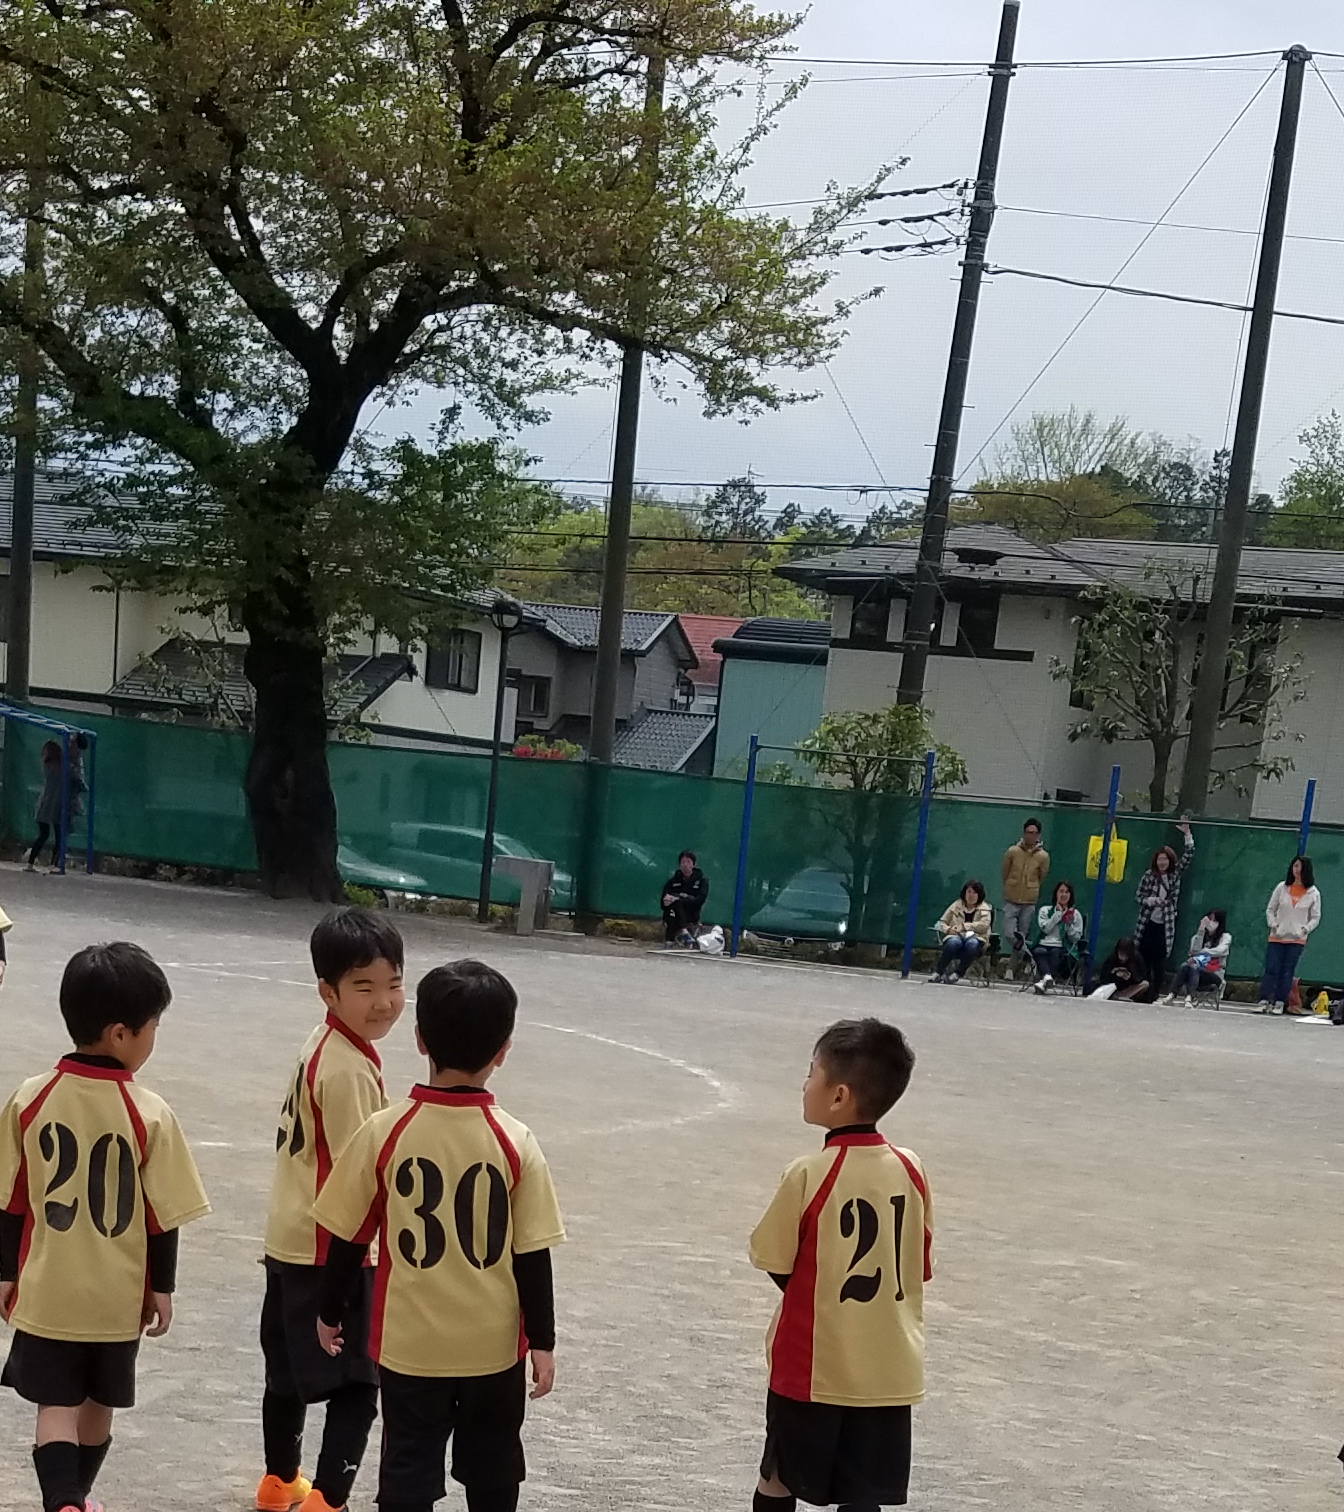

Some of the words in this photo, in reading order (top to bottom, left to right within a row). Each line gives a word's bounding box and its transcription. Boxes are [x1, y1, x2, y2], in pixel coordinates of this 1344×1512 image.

[38, 1121, 136, 1238] 20
[395, 1156, 509, 1270] 30
[839, 1194, 906, 1304] 21
